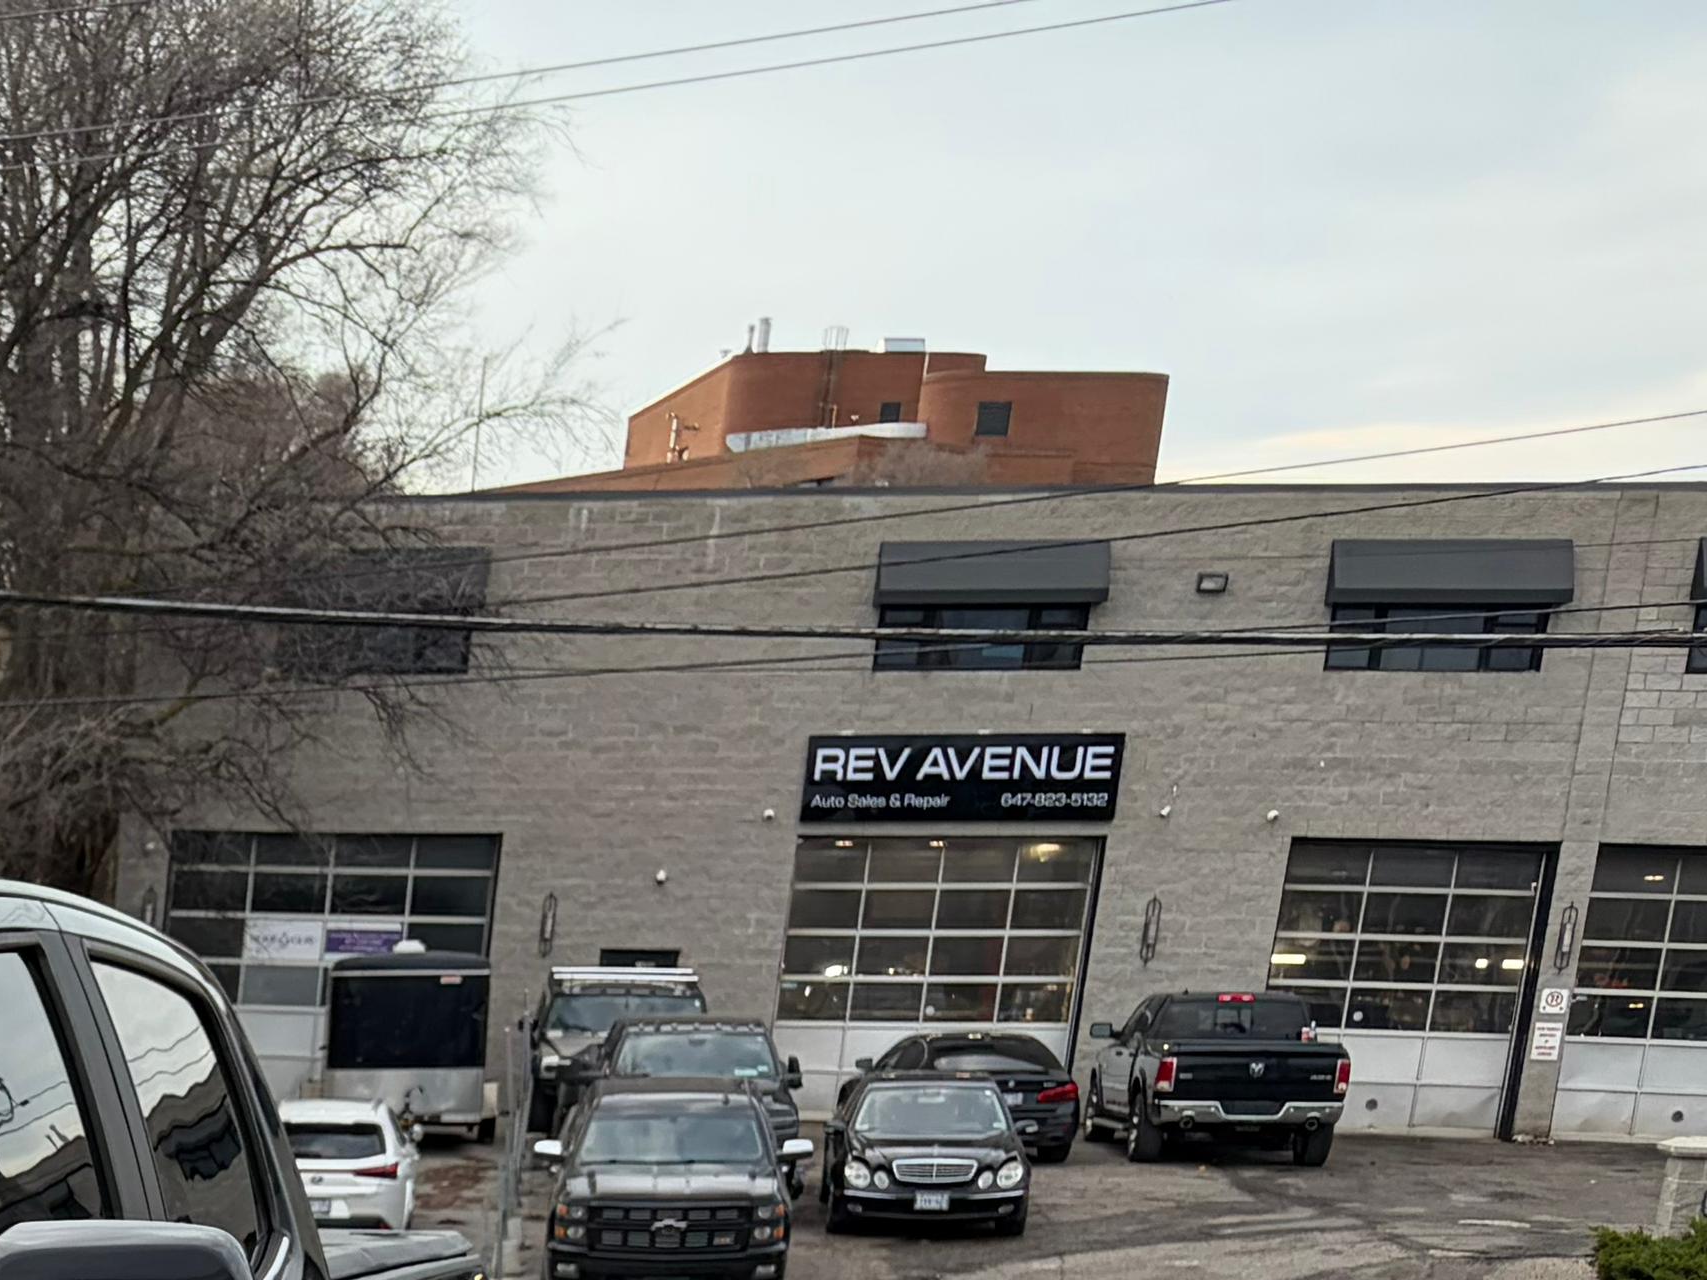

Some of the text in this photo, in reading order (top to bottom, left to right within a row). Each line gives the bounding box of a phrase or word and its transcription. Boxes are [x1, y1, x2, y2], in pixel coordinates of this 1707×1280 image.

[813, 745, 1116, 782] REV AVENUE
[810, 792, 951, 810] Auto Sales & Repair
[1000, 792, 1109, 808] 647-823-5132
